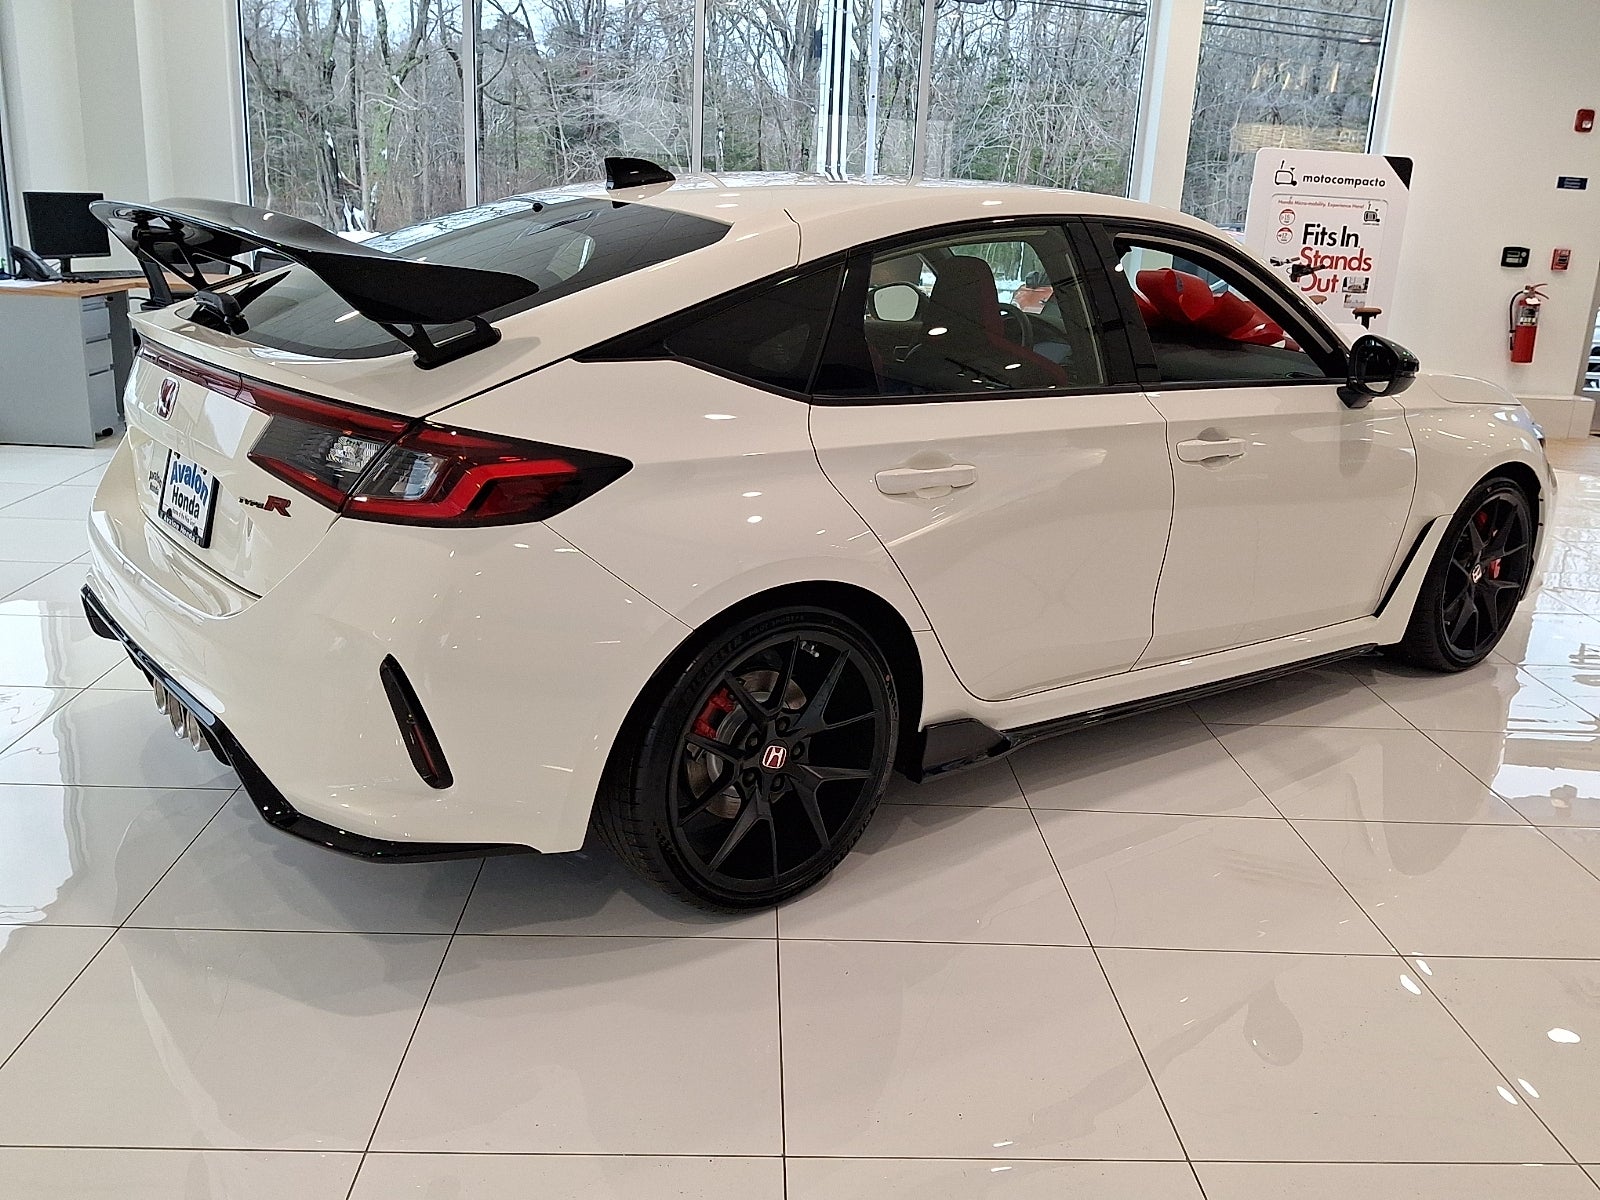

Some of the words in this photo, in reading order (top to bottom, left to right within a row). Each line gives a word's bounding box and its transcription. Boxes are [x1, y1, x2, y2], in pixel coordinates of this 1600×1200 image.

[1302, 174, 1386, 189] motocompacto
[1302, 223, 1337, 247] Fits
[1300, 247, 1372, 272] Stands
[169, 460, 209, 507] Avalon
[171, 484, 200, 520] Honda
[264, 494, 292, 517] R
